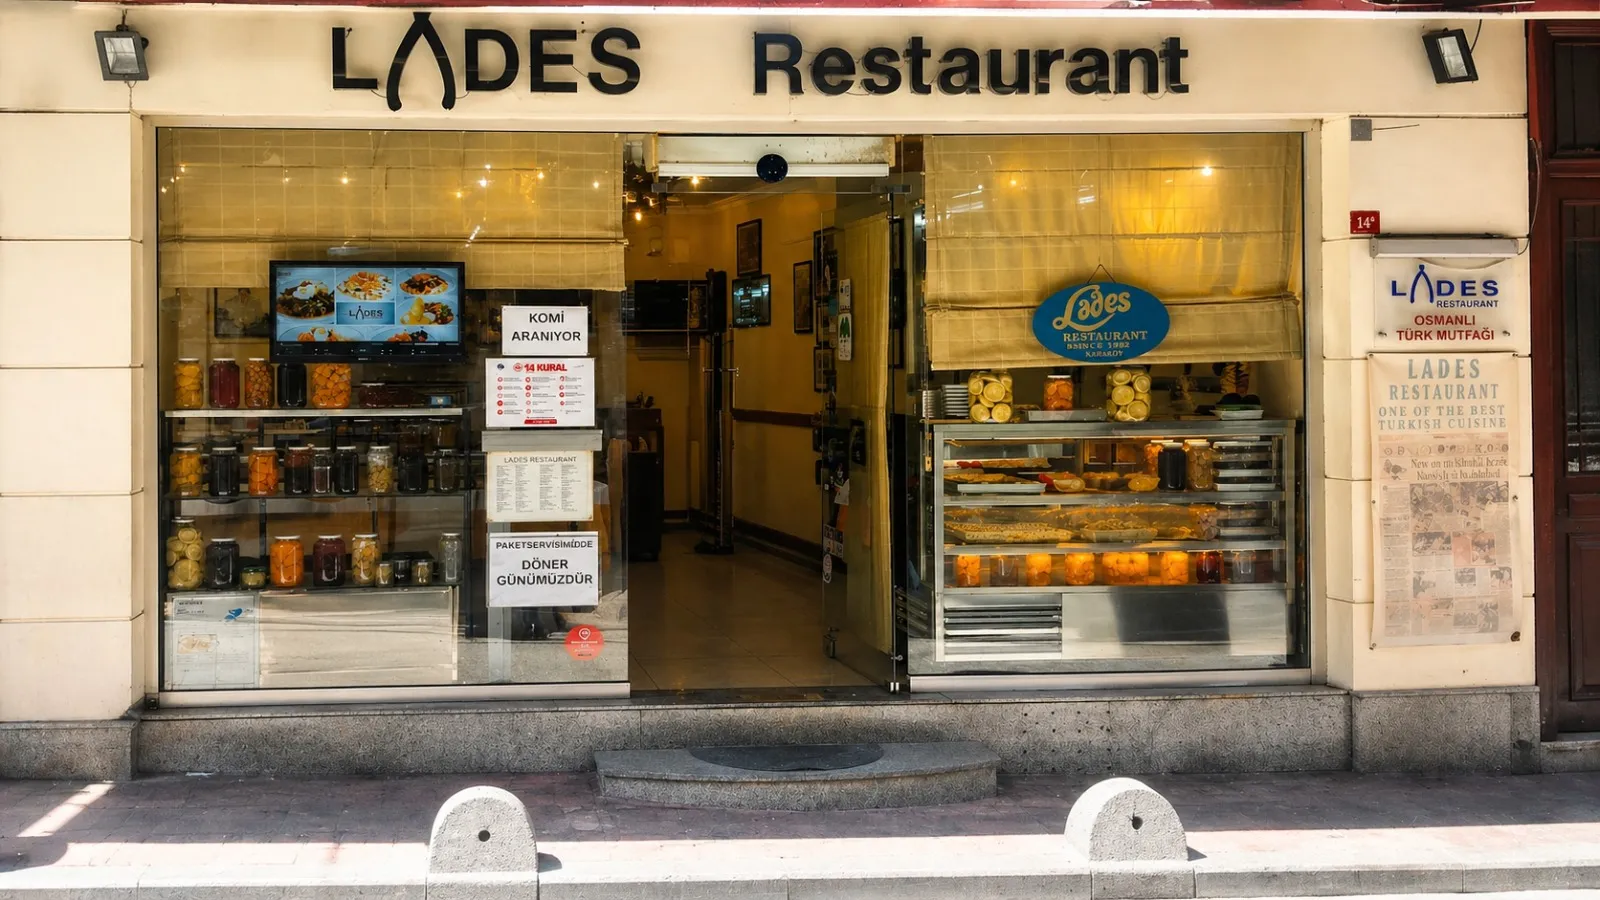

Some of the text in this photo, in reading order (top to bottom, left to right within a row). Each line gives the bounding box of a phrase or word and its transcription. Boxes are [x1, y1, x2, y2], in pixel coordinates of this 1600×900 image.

[332, 12, 1189, 111] LADES Restaurant
[1391, 264, 1499, 304] LADES
[1052, 284, 1132, 332] Lades
[1436, 300, 1499, 308] RESTAURANT
[529, 310, 565, 323] KOMİ
[1414, 315, 1476, 326] OSMANLI
[511, 331, 582, 342] ARANIYOR
[1063, 331, 1148, 342] RESTAURANT
[1396, 327, 1495, 341] TÜRK MUTFAĞI
[524, 363, 568, 372] 14 KURAL
[1408, 359, 1481, 379] LADES
[1389, 384, 1499, 400] RESTAURANT
[1378, 405, 1506, 417] ONE OF THE BEST
[1378, 418, 1507, 431] TURKISH CUISINE
[504, 456, 528, 464] LADES
[522, 557, 569, 570] DÖNER
[497, 572, 593, 586] GÜNÜMÜZDÜR
